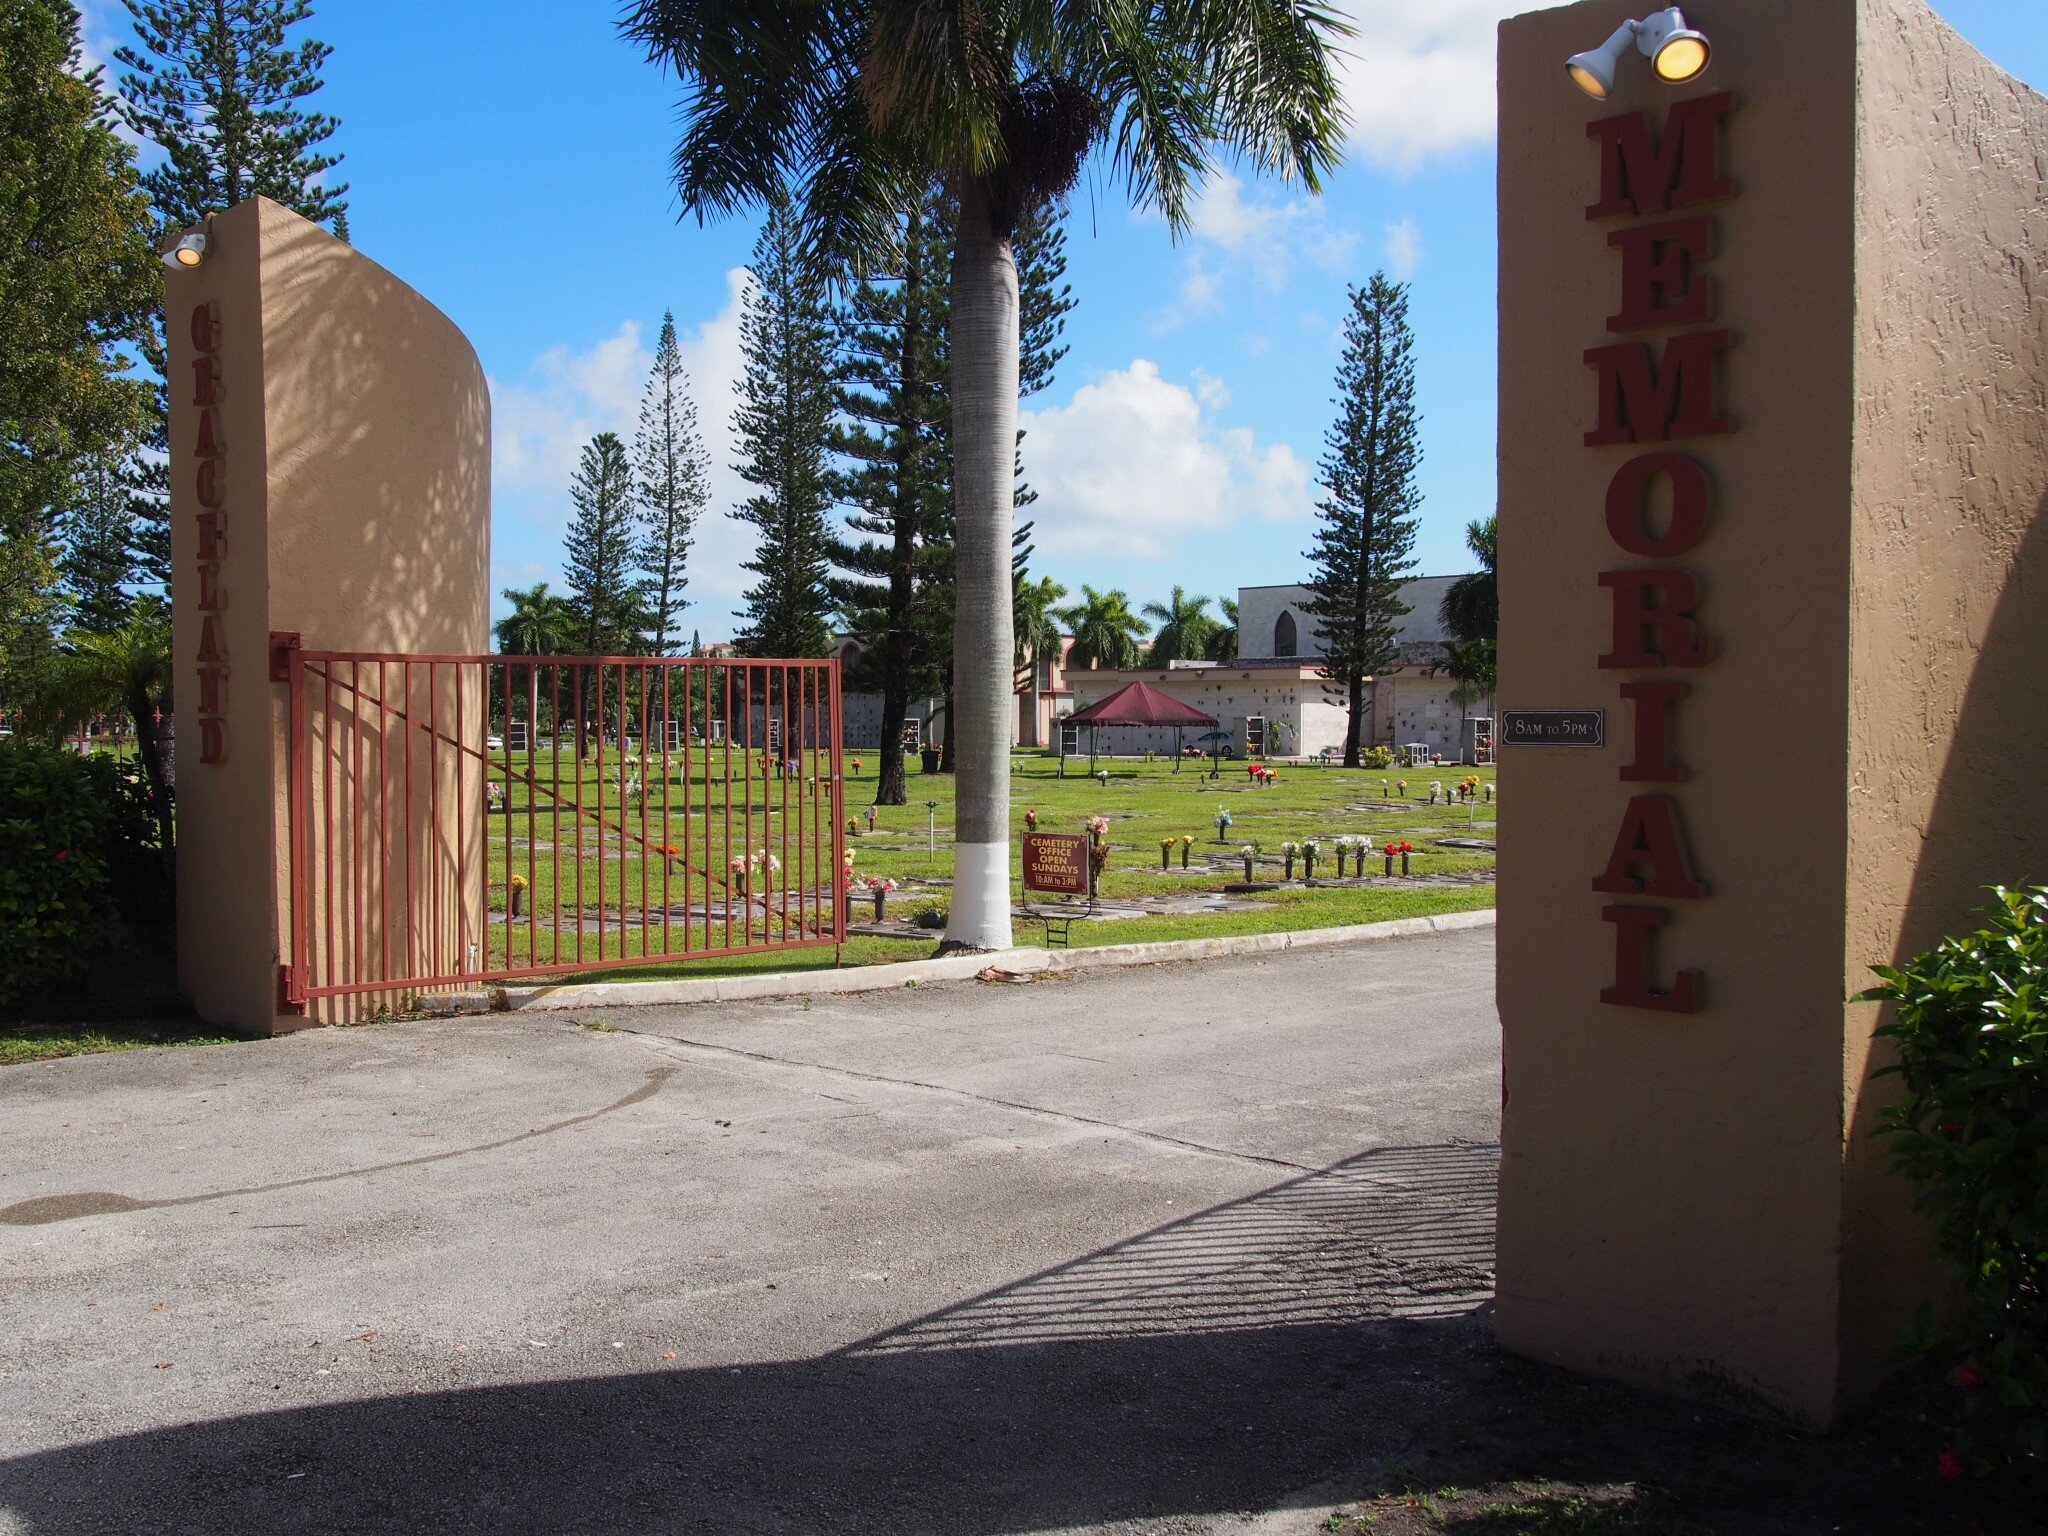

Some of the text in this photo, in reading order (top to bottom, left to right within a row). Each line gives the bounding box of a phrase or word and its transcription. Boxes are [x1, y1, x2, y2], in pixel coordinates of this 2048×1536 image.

[190, 302, 230, 765] GRACELAND
[1584, 90, 1738, 1014] MEMORIAL
[1515, 719, 1542, 735] 8AM
[1562, 720, 1587, 735] 5PM
[1031, 838, 1079, 848] CEMETERY
[1038, 847, 1072, 856] OFFICE
[1040, 855, 1067, 865] OPEN
[1032, 863, 1078, 874] SUNDAYS
[1062, 878, 1076, 886] 3:PM
